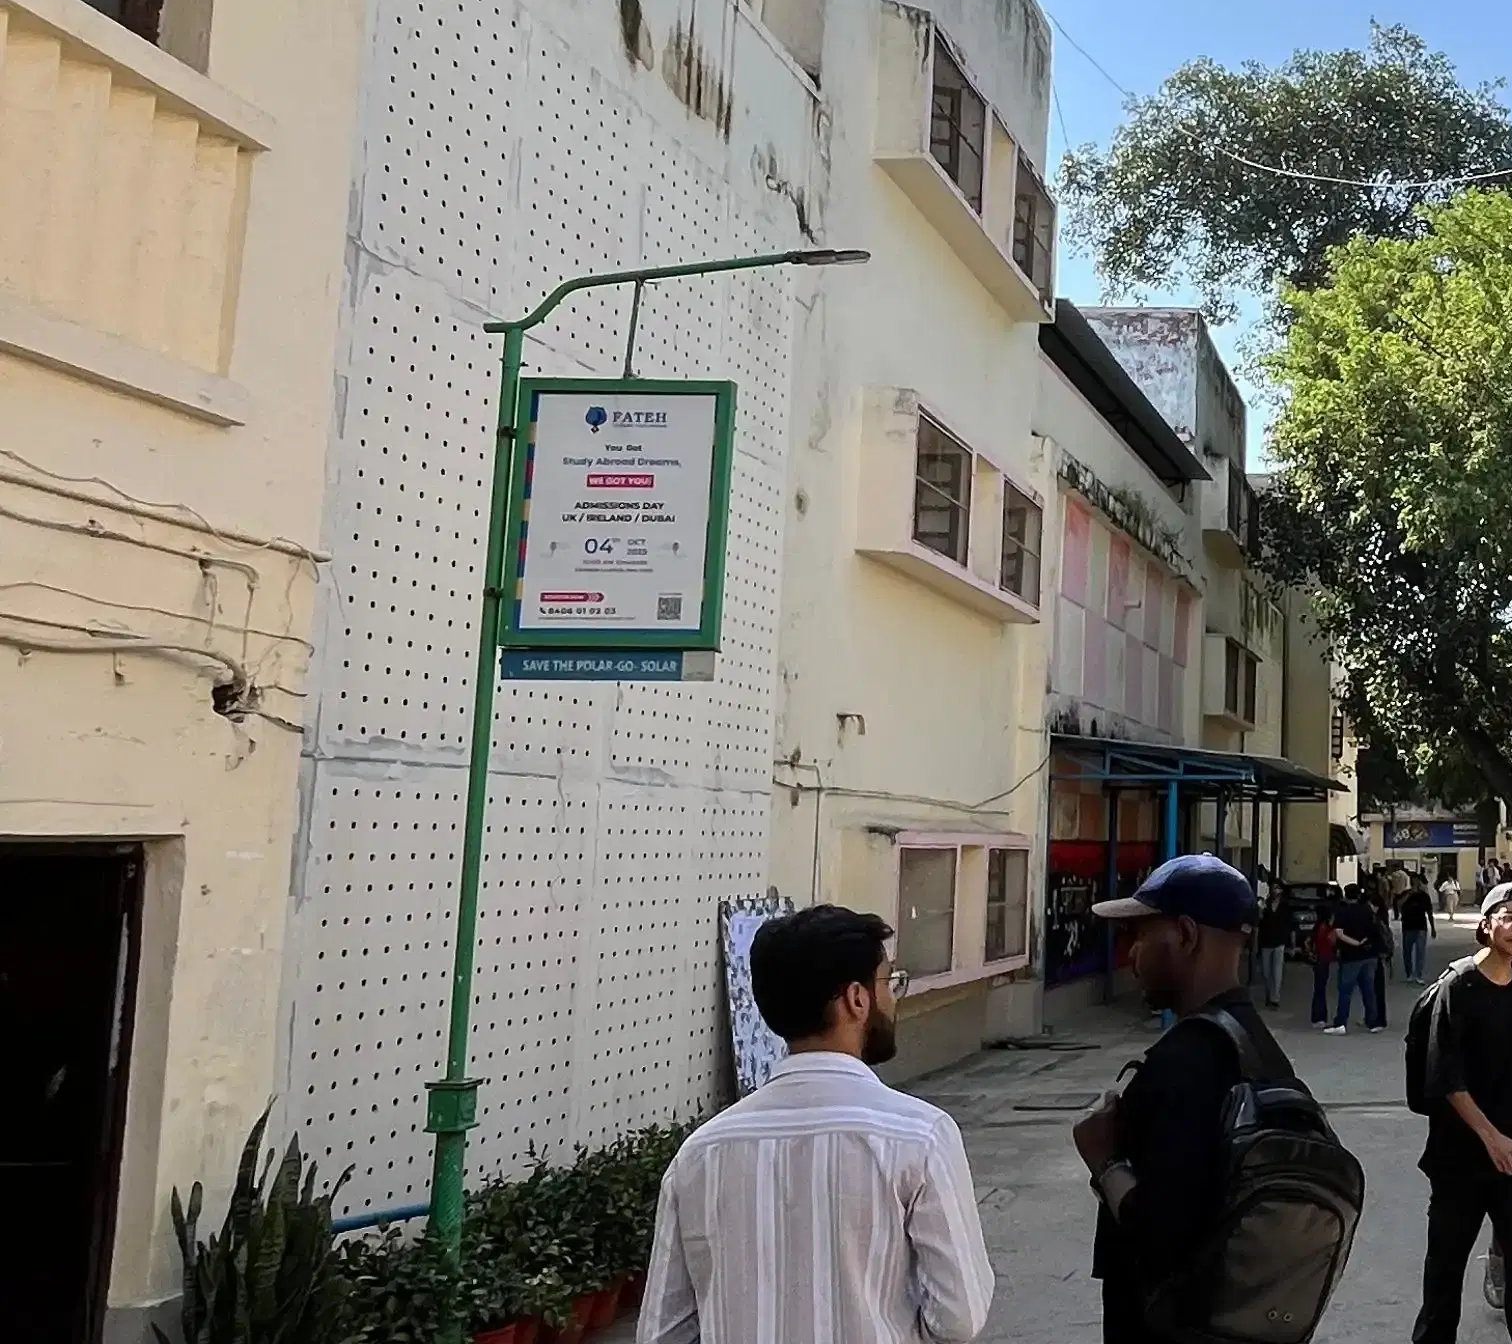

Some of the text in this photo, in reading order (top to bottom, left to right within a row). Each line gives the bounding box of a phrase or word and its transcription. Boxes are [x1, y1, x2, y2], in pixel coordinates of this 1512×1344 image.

[612, 411, 668, 423] FATEH
[605, 444, 642, 452] You Got
[562, 457, 592, 467] Study
[596, 457, 635, 466] Abroad
[588, 477, 604, 485] WE
[606, 477, 626, 485] GOT
[574, 502, 665, 511] ADMISSIONS DAY
[562, 514, 576, 523] UK
[587, 514, 632, 523] IRELAND
[642, 514, 675, 523] DUBAI
[523, 660, 550, 671] SAVE
[553, 660, 573, 671] THE
[641, 661, 678, 672] SOLAR
